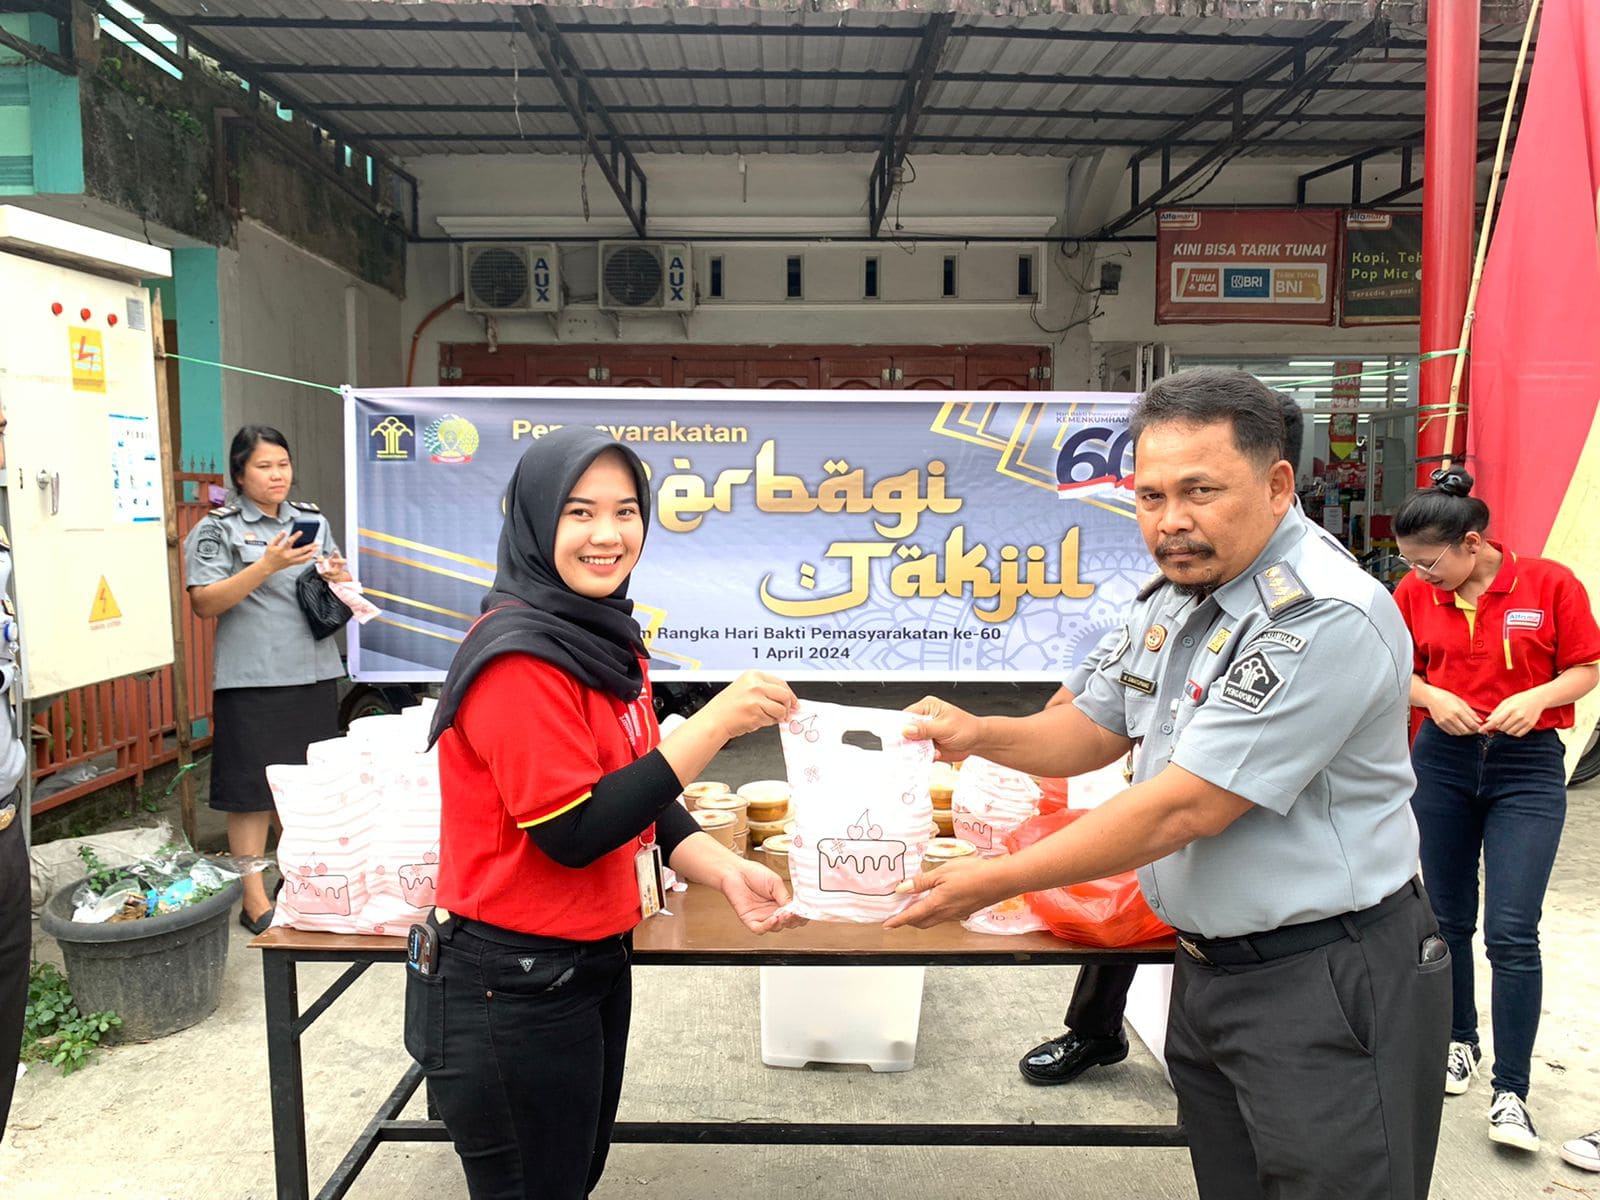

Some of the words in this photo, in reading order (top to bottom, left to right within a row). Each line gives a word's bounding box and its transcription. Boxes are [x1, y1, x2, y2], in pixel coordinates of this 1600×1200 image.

[1173, 243, 1202, 256] KINI
[1204, 243, 1237, 256] BISA
[1240, 243, 1281, 256] TARIK
[1285, 243, 1327, 256] TUNAI
[1352, 252, 1390, 266] Kopi,
[534, 257, 550, 303] AUX
[669, 257, 685, 302] AUX
[1190, 274, 1216, 282] TUNAI
[1243, 276, 1263, 288] BRI
[1351, 268, 1378, 282] Pop
[1383, 268, 1409, 279] Mie
[1275, 280, 1303, 293] BNI
[1056, 416, 1130, 424] KEMENKUMHAM
[641, 439, 963, 539] erbagi
[759, 525, 1096, 623] Takjil
[657, 626, 720, 643] Rangka
[724, 626, 759, 640] Hari
[763, 626, 806, 640] Bakti
[811, 626, 948, 643] Pemasyarakatan
[953, 626, 1002, 641] ke-60
[752, 647, 759, 659] 1
[766, 646, 804, 661] April
[808, 646, 851, 659] 2024
